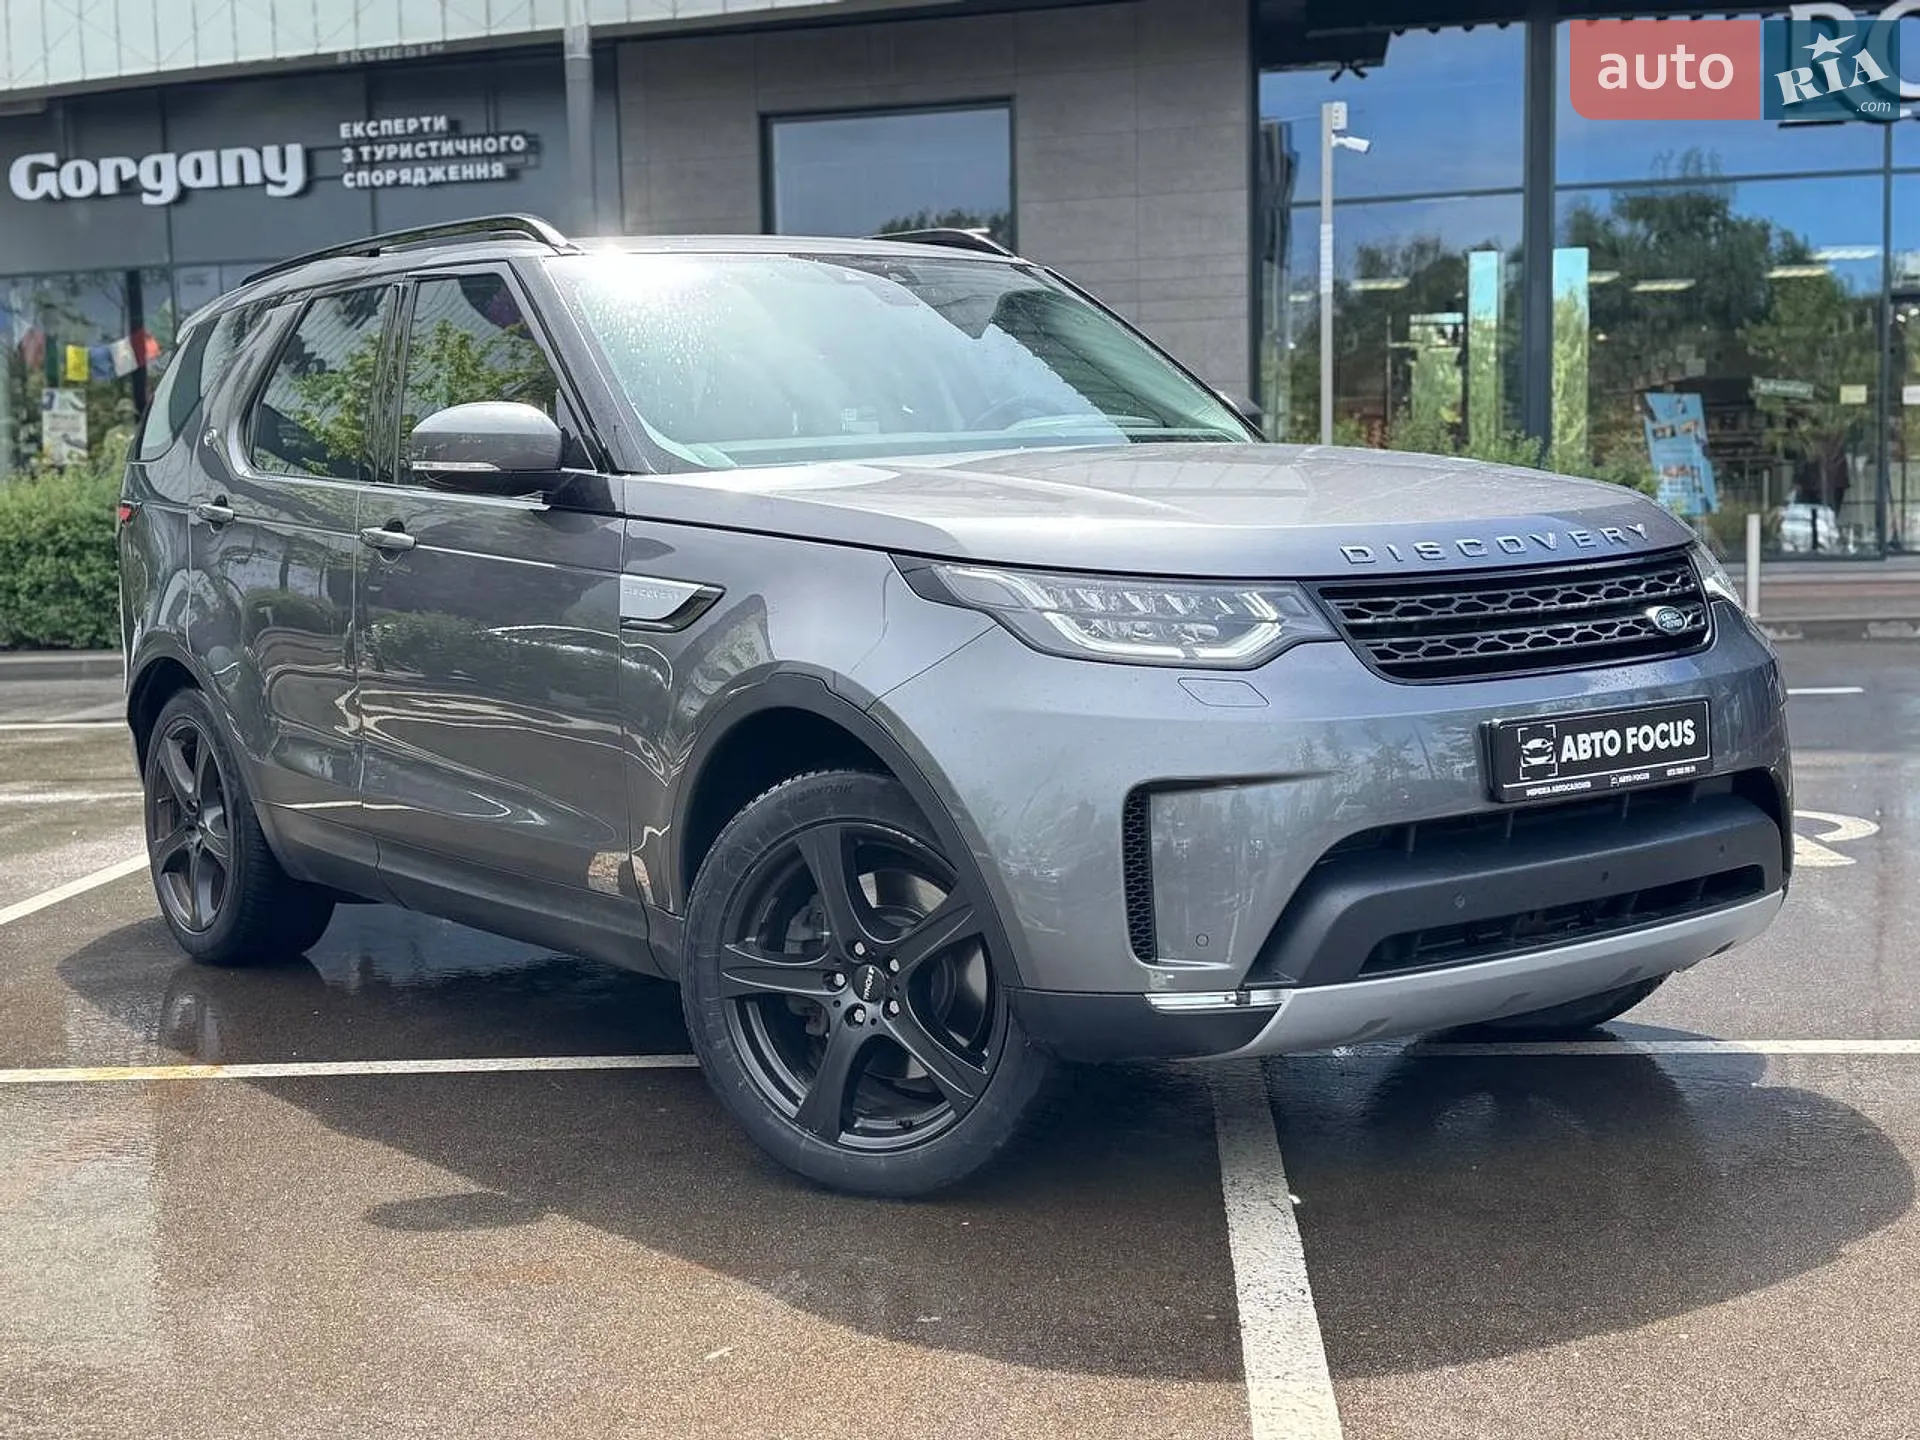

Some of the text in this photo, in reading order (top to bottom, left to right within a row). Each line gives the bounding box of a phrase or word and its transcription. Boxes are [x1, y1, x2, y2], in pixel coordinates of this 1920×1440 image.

[340, 116, 448, 138] ЕКСПЕРТИ
[359, 135, 525, 161] ТУРИСТИЧНОГО
[9, 142, 303, 205] Gorgany
[343, 162, 505, 187] СПОРЯДЖЕННЯ
[1340, 523, 1650, 564] DISCOVERY
[1626, 719, 1695, 754] FOCUS
